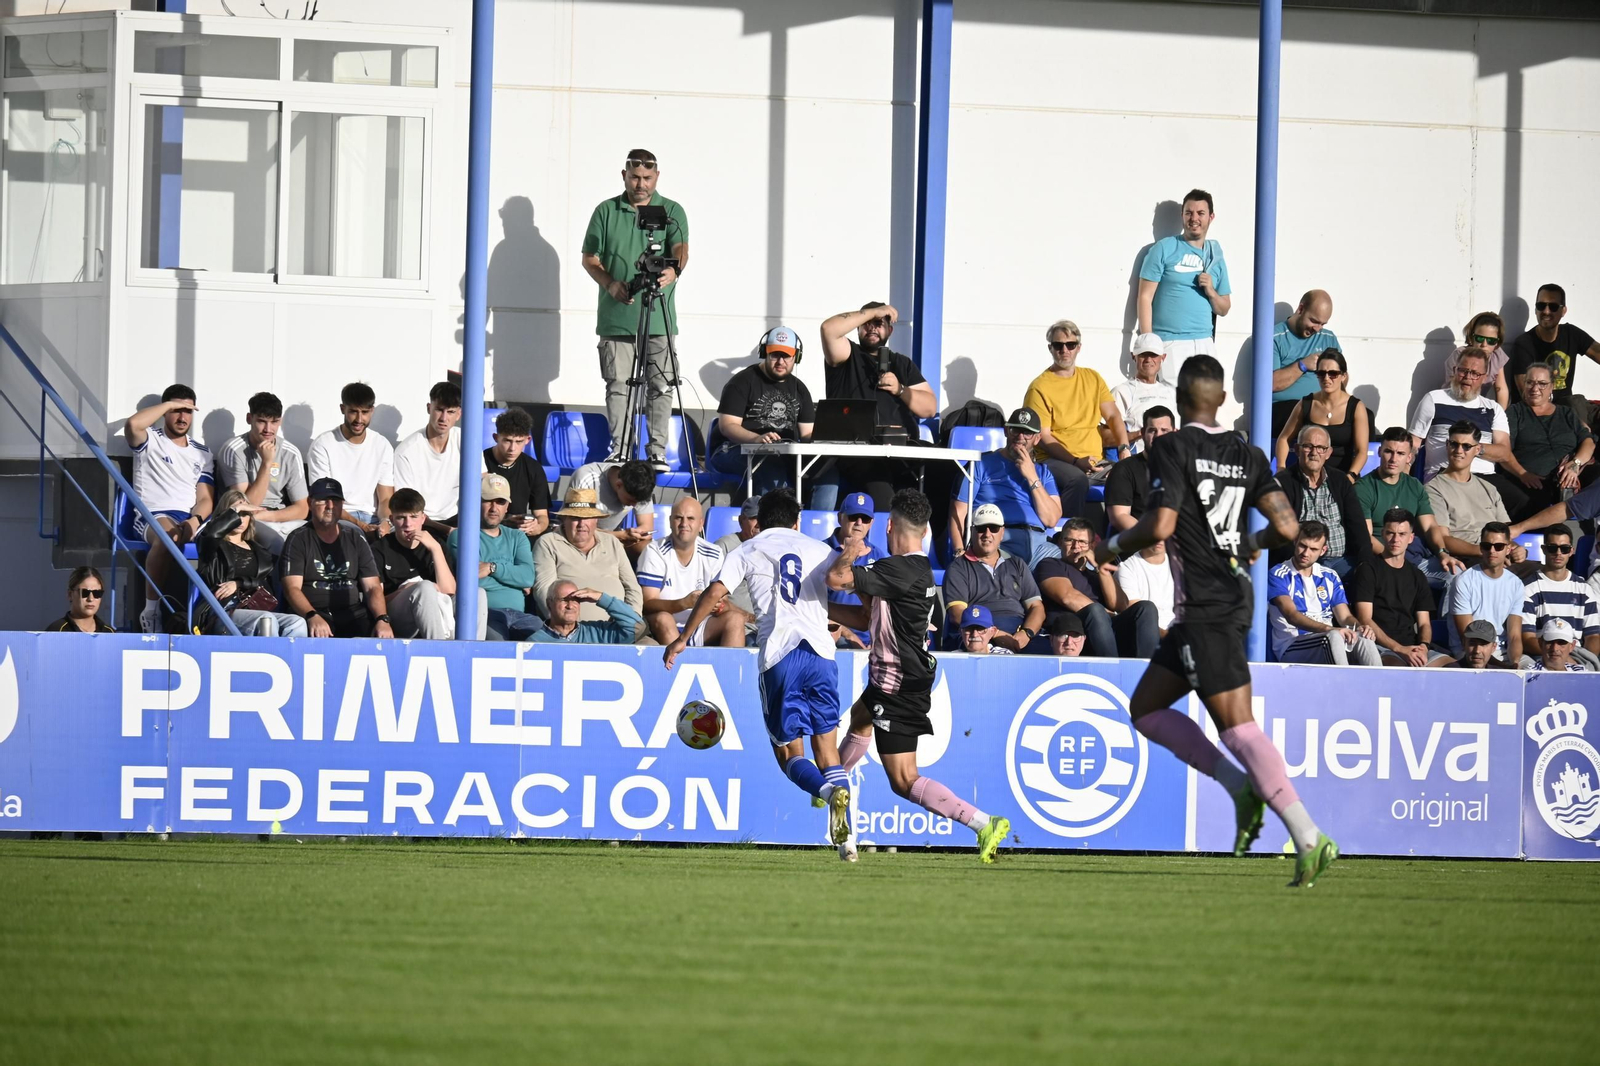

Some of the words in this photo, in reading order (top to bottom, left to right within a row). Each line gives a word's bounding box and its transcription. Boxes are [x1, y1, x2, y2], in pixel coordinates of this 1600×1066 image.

[780, 553, 802, 605] 8
[121, 650, 743, 751] PRIMERA
[120, 756, 741, 832] FEDERACIÓN
[828, 804, 953, 835] erdrola
[1391, 792, 1489, 828] original
